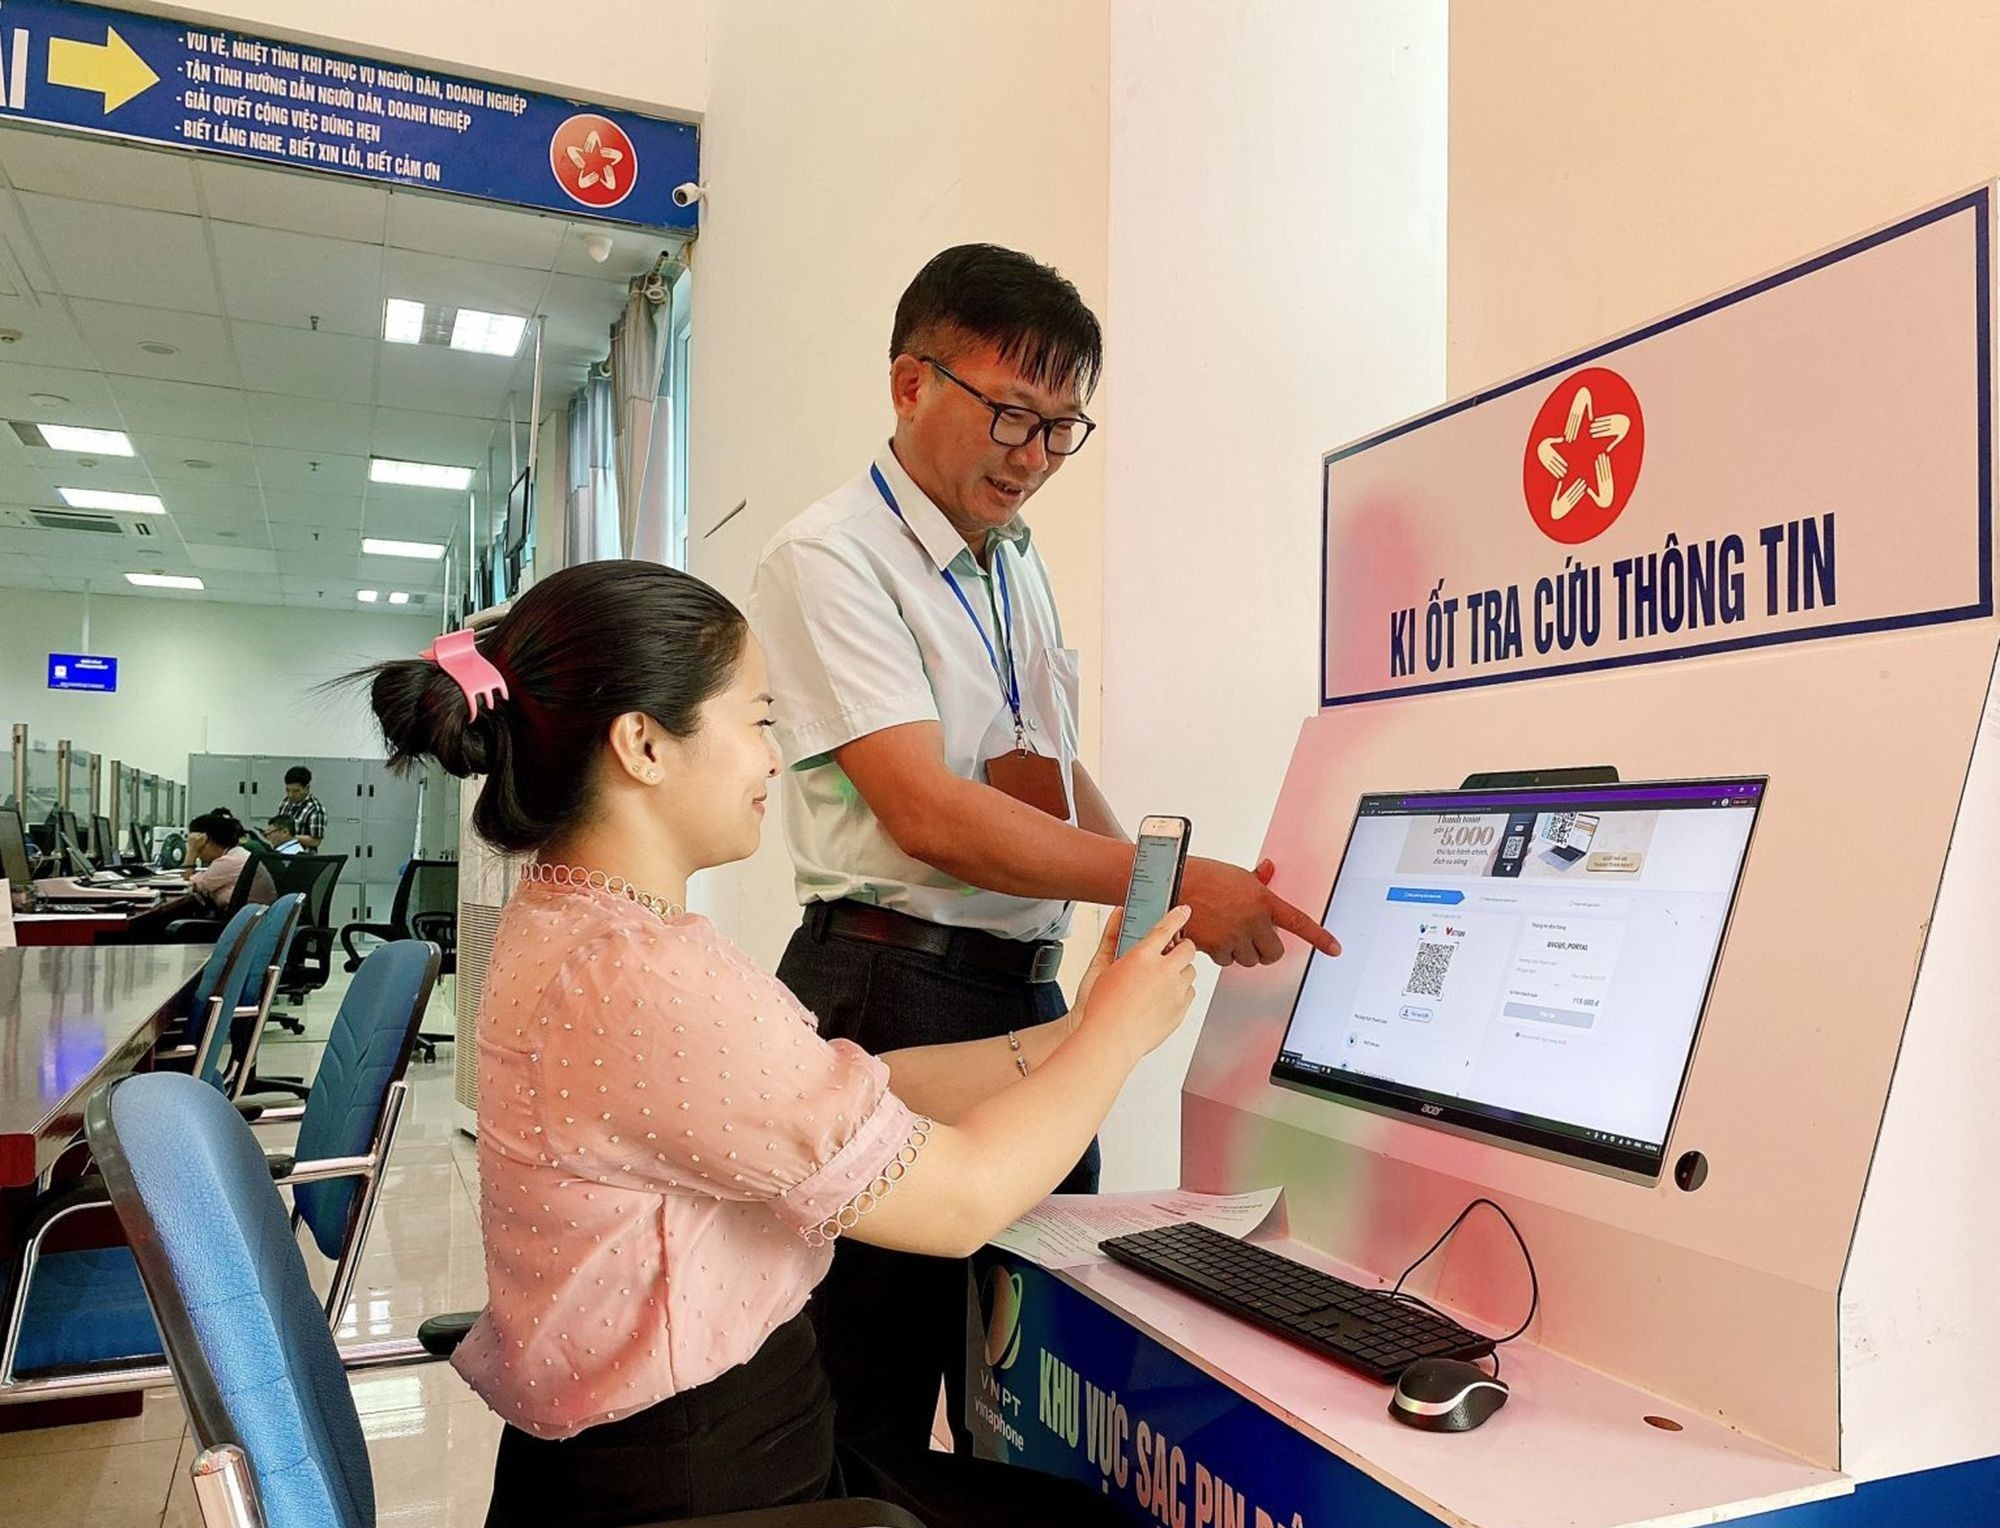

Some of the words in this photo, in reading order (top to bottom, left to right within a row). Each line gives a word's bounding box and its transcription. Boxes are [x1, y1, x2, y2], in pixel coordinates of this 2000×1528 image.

[186, 58, 210, 84] TẬN
[213, 63, 242, 88] TÌNH
[318, 86, 355, 110] NGƯỜI
[357, 92, 385, 117] DÂN,
[388, 99, 426, 123] DOANH
[430, 109, 471, 134] NGHIỆP
[187, 31, 207, 52] VUI
[210, 32, 230, 58] VẺ,
[232, 41, 268, 66] NHIỆT
[271, 46, 299, 70] TÌNH
[301, 54, 322, 74] KHI
[325, 59, 357, 83] PHỤC
[360, 65, 375, 88] VỤ
[378, 70, 413, 93] NGƯỜI
[416, 75, 443, 101] DÂN,
[446, 83, 484, 106] DOANH
[487, 91, 528, 117] NGHIỆP
[183, 117, 212, 140] BIẾT
[249, 131, 286, 156] NGHE,
[289, 136, 316, 159] BIẾT
[318, 143, 339, 164] XIN
[342, 143, 364, 170] LỖI,
[366, 150, 392, 173] BIẾT
[395, 153, 421, 178] CẢM
[424, 161, 441, 182] ƠN
[185, 87, 211, 112] GIẢI
[213, 95, 252, 119] QUYẾT
[291, 109, 318, 133] VIỆC
[356, 121, 381, 145] HẸN
[1390, 607, 1416, 678] KI
[1425, 578, 1458, 673] ỐT
[1466, 584, 1523, 665] TRA
[1533, 556, 1601, 655] CỨU
[1613, 532, 1745, 641] THÔNG
[1759, 512, 1837, 617] TIN
[1421, 1103, 1443, 1116] acer
[980, 1369, 1021, 1417] VNPT
[1040, 1347, 1080, 1449] KHU
[1086, 1380, 1128, 1494] VỰC
